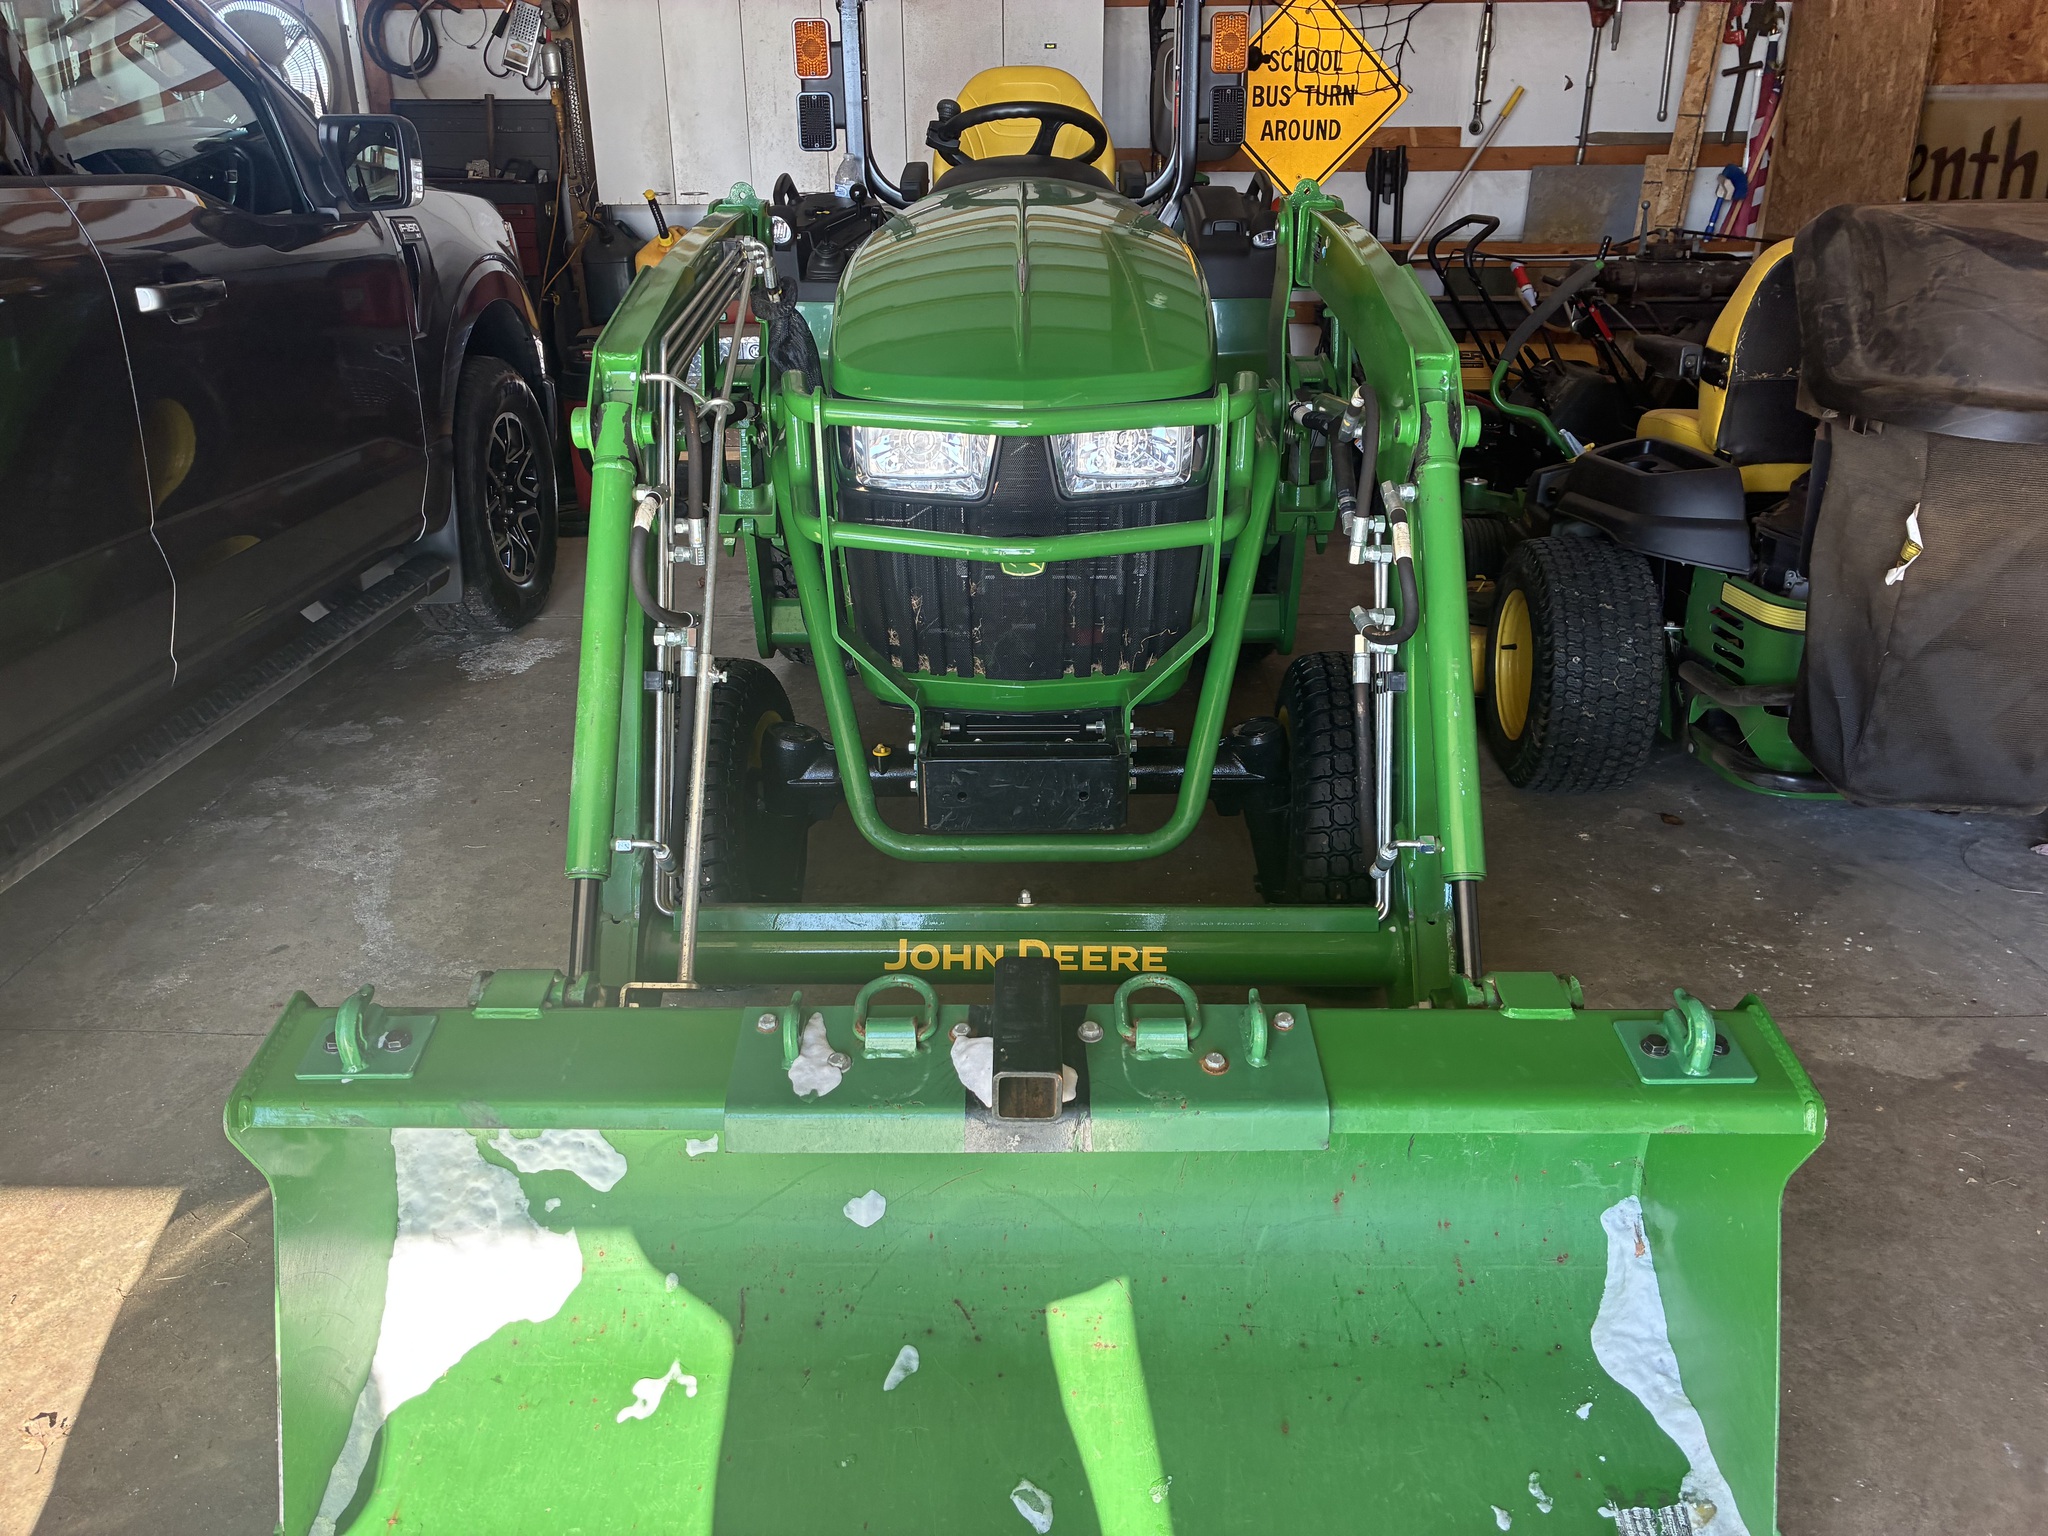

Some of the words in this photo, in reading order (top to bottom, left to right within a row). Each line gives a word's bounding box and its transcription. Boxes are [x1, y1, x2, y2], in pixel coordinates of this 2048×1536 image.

[1267, 49, 1343, 72] SCHOOL
[1252, 85, 1292, 107] BUS
[1304, 84, 1355, 106] TURN
[1260, 119, 1342, 142] AROUND
[1906, 116, 2048, 202] enth
[399, 223, 420, 233] F-150
[883, 938, 1004, 971] JOHN
[1018, 938, 1168, 972] DEERE
